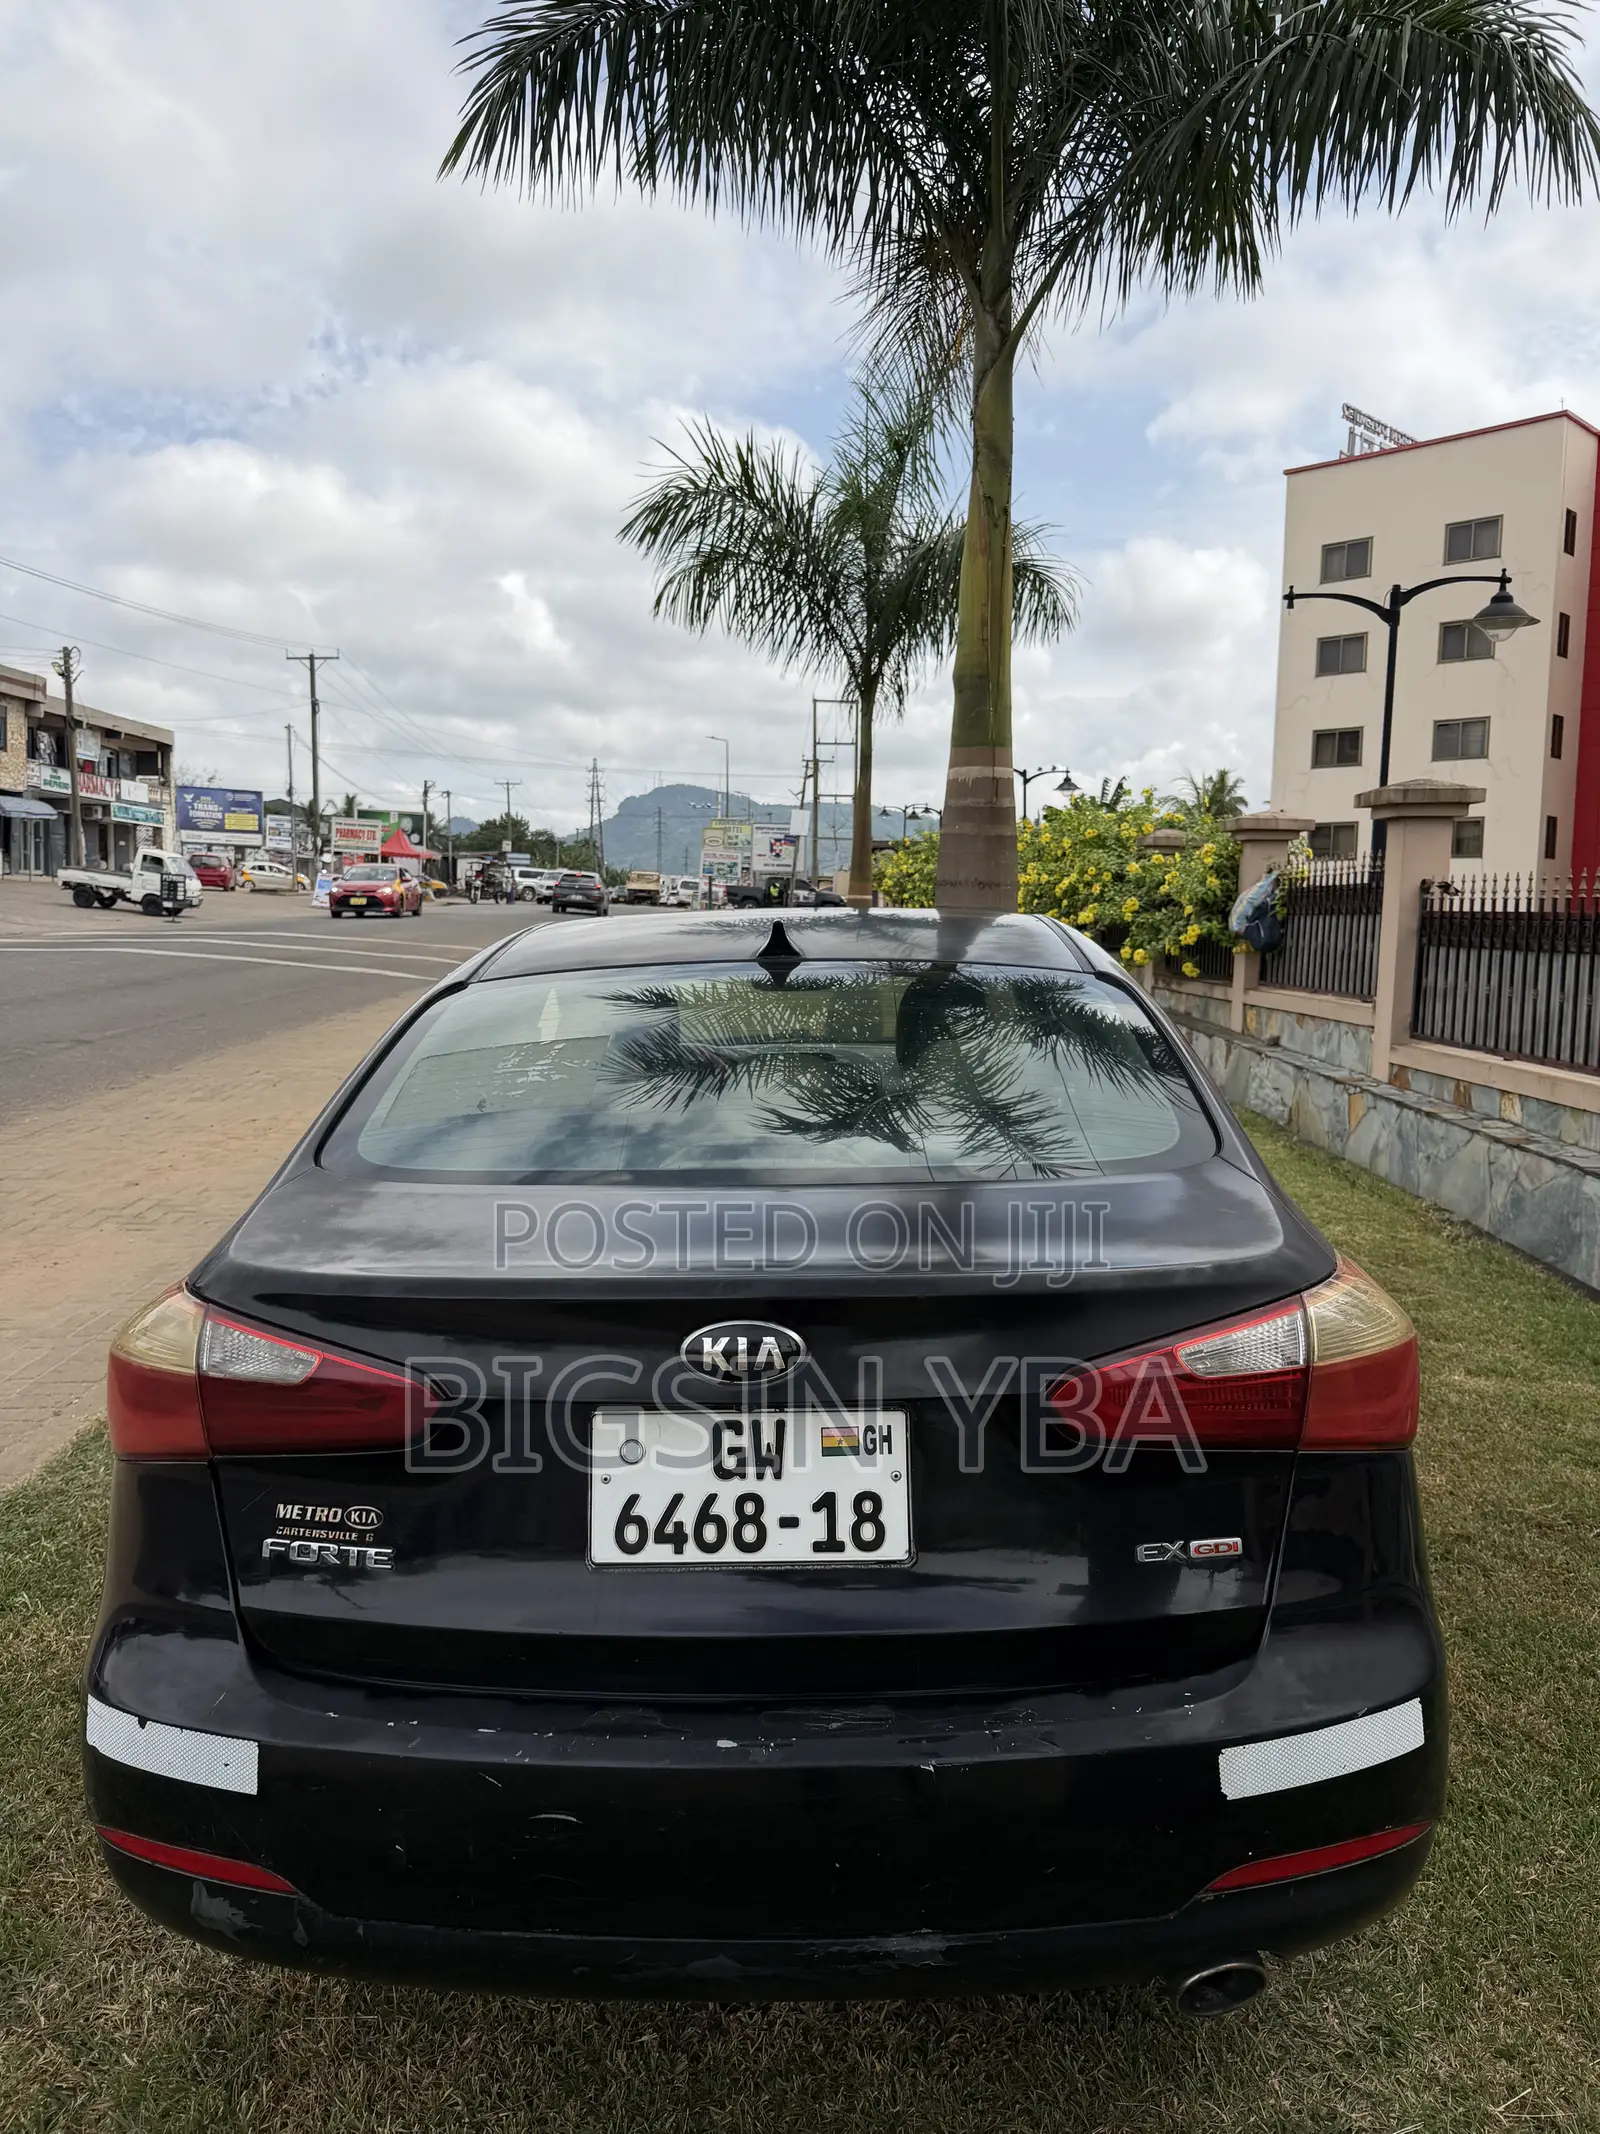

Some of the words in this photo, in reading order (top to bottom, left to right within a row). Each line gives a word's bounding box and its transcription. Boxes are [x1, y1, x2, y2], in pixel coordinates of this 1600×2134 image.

[78, 773, 114, 798] ARMACY
[335, 828, 366, 840] PHARMACY
[701, 1335, 784, 1371] KIA
[711, 1419, 786, 1481] GW
[863, 1425, 893, 1455] GH
[275, 1503, 342, 1523] METRO
[350, 1510, 378, 1524] KIA
[614, 1490, 886, 1556] 6468-18
[276, 1526, 358, 1540] CARTERSVILLE
[261, 1538, 395, 1570] FORTE
[1136, 1541, 1187, 1562] EX
[1194, 1541, 1238, 1556] GDI
